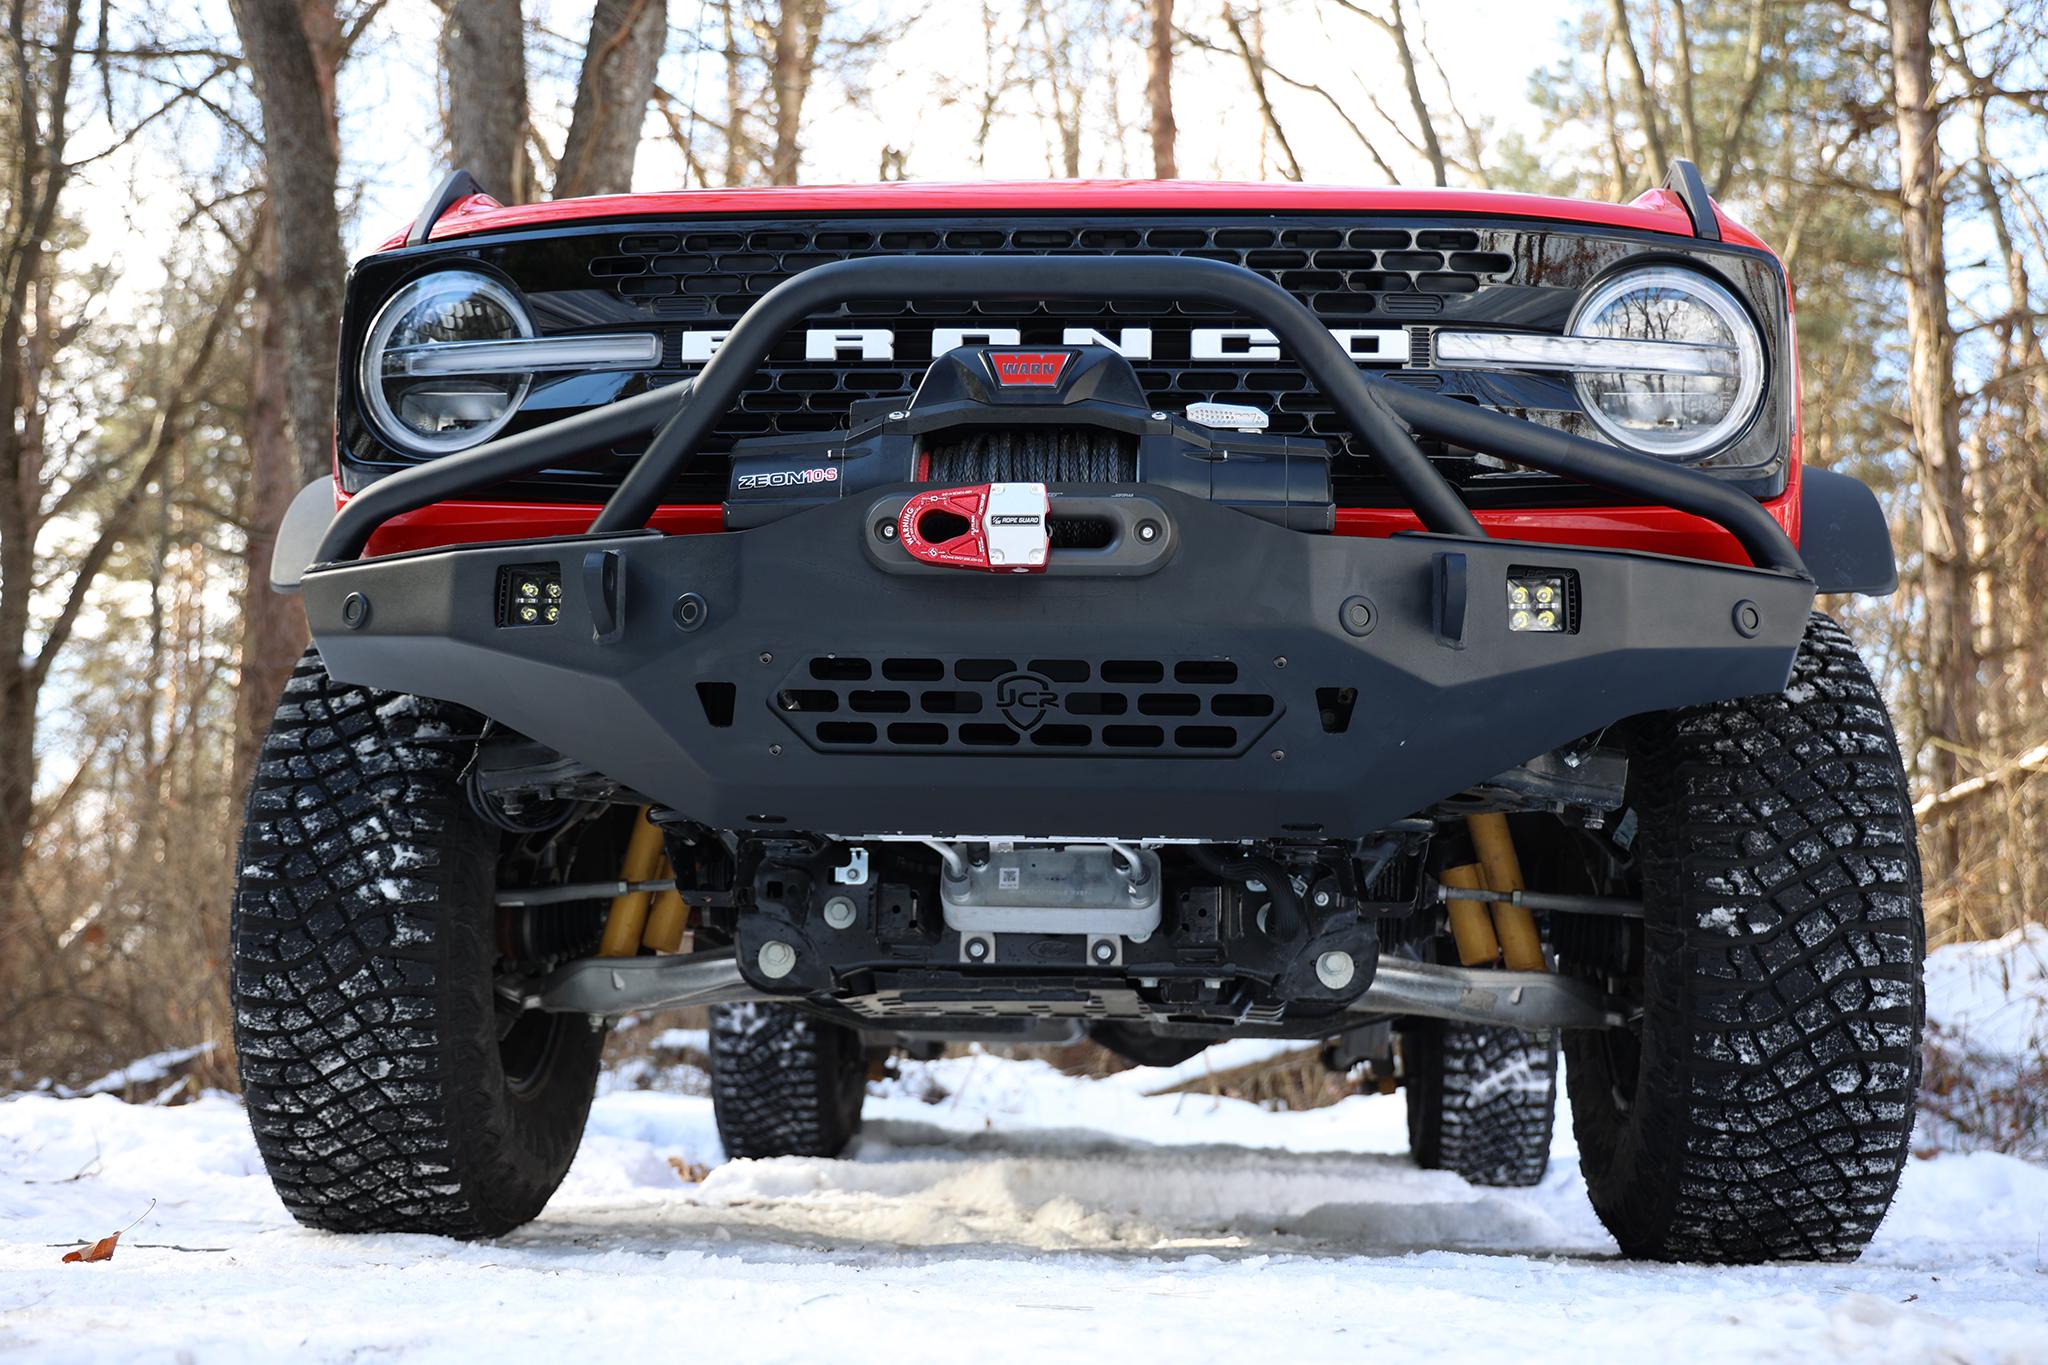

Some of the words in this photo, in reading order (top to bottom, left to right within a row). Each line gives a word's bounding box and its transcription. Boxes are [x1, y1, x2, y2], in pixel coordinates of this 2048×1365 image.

[1002, 363, 1054, 375] WARN
[902, 507, 914, 546] WARNING
[996, 688, 1059, 708] JCR
